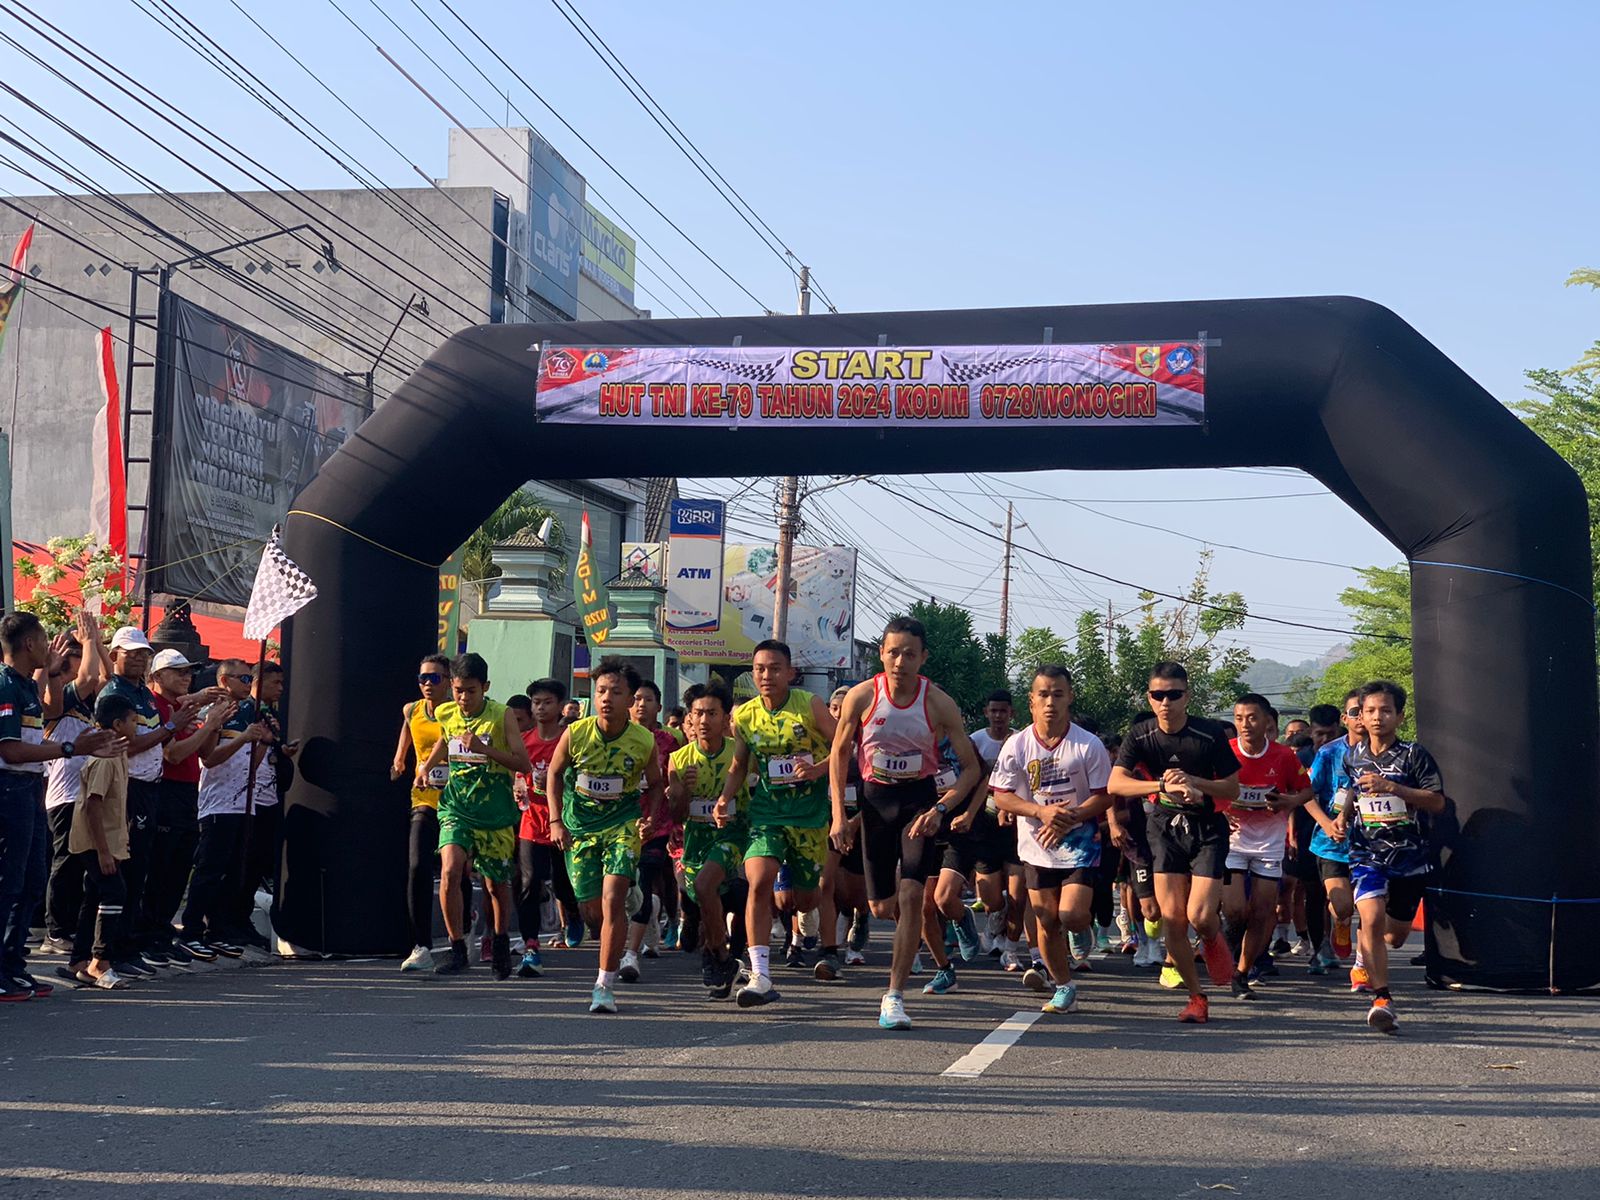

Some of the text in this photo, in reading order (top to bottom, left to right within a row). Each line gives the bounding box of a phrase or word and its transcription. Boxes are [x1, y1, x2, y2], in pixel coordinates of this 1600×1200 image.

[790, 350, 932, 380] START
[600, 383, 1158, 418] HUT TNI KE-79 TAHUN 2024 KODIM 0728/WONOGIRI
[693, 509, 715, 524] BRI
[677, 567, 711, 580] ATM
[779, 762, 793, 775] 10
[885, 759, 907, 770] 110
[588, 780, 610, 792] 103
[1243, 791, 1261, 801] 181
[1369, 800, 1392, 812] 174
[1136, 869, 1147, 883] 12
